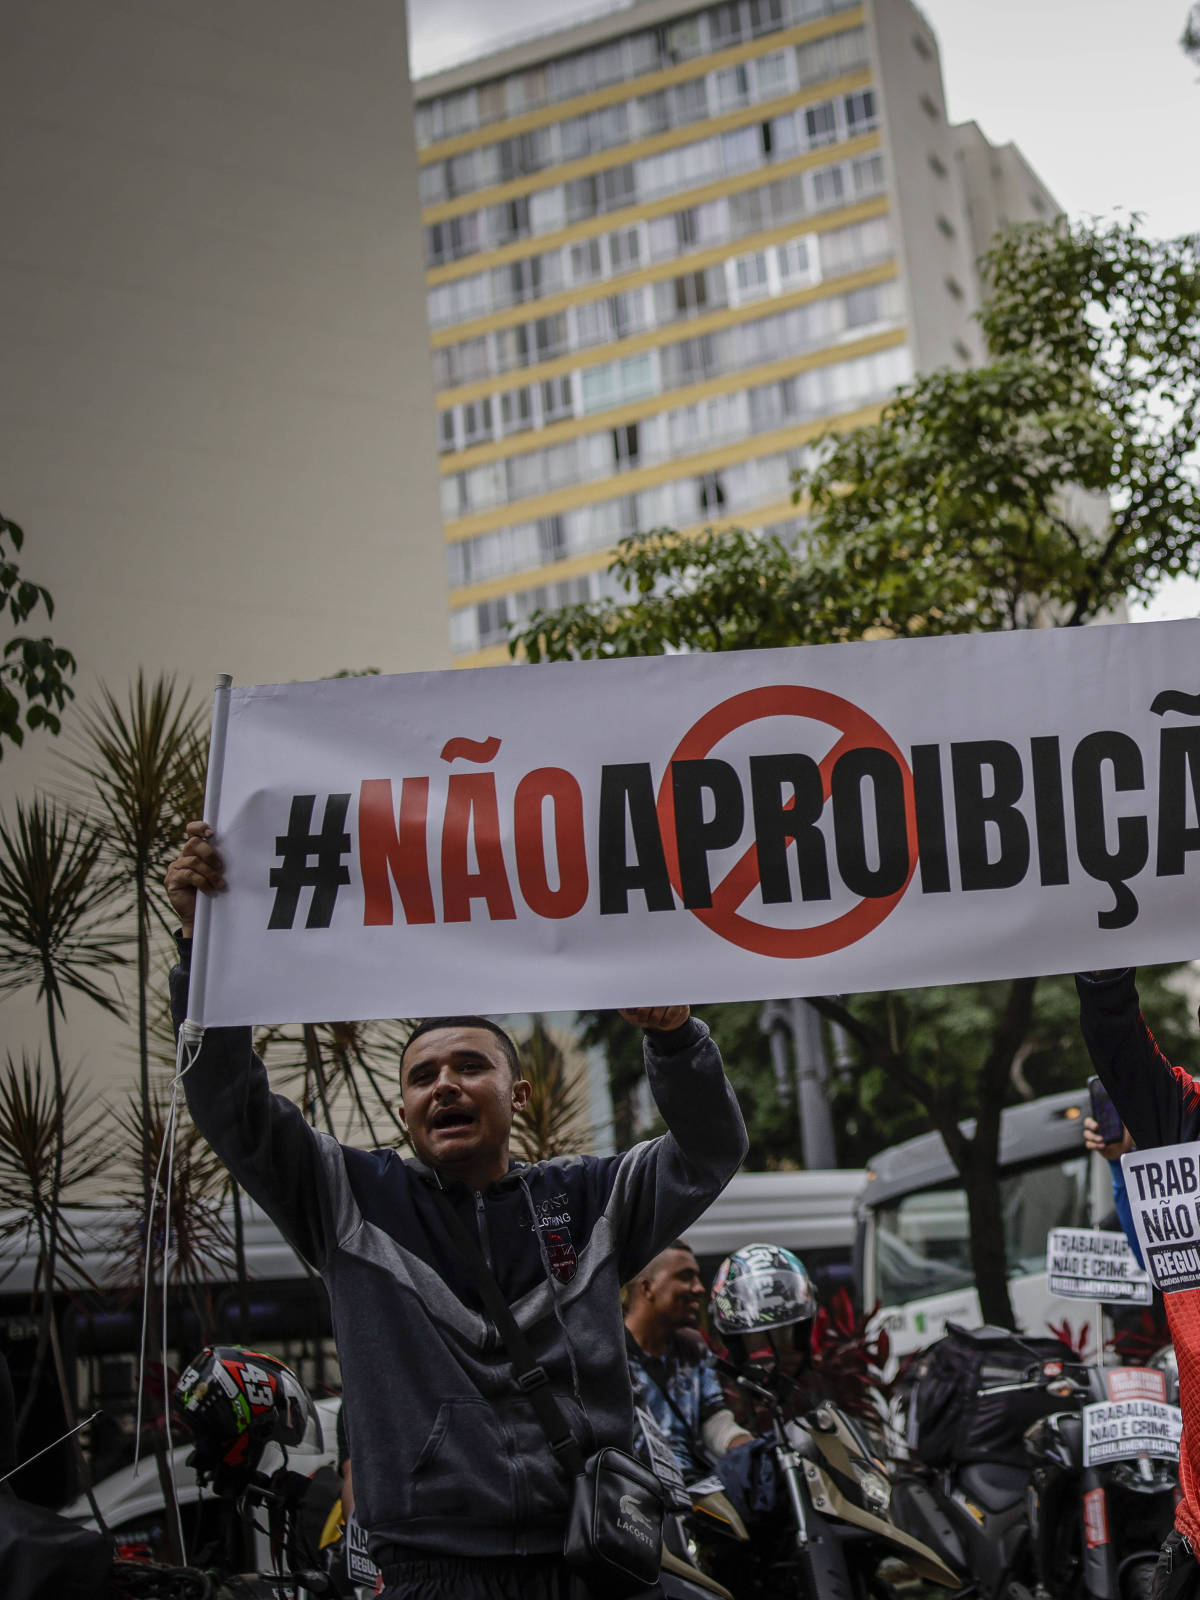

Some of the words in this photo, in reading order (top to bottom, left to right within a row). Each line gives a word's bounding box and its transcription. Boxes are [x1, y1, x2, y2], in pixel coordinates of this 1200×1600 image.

[1141, 1199, 1194, 1243] NÃO
[1053, 1234, 1129, 1257] TRABALHAR
[1089, 1402, 1169, 1425] TRABALHAR
[616, 1517, 654, 1549] LACOSTE
